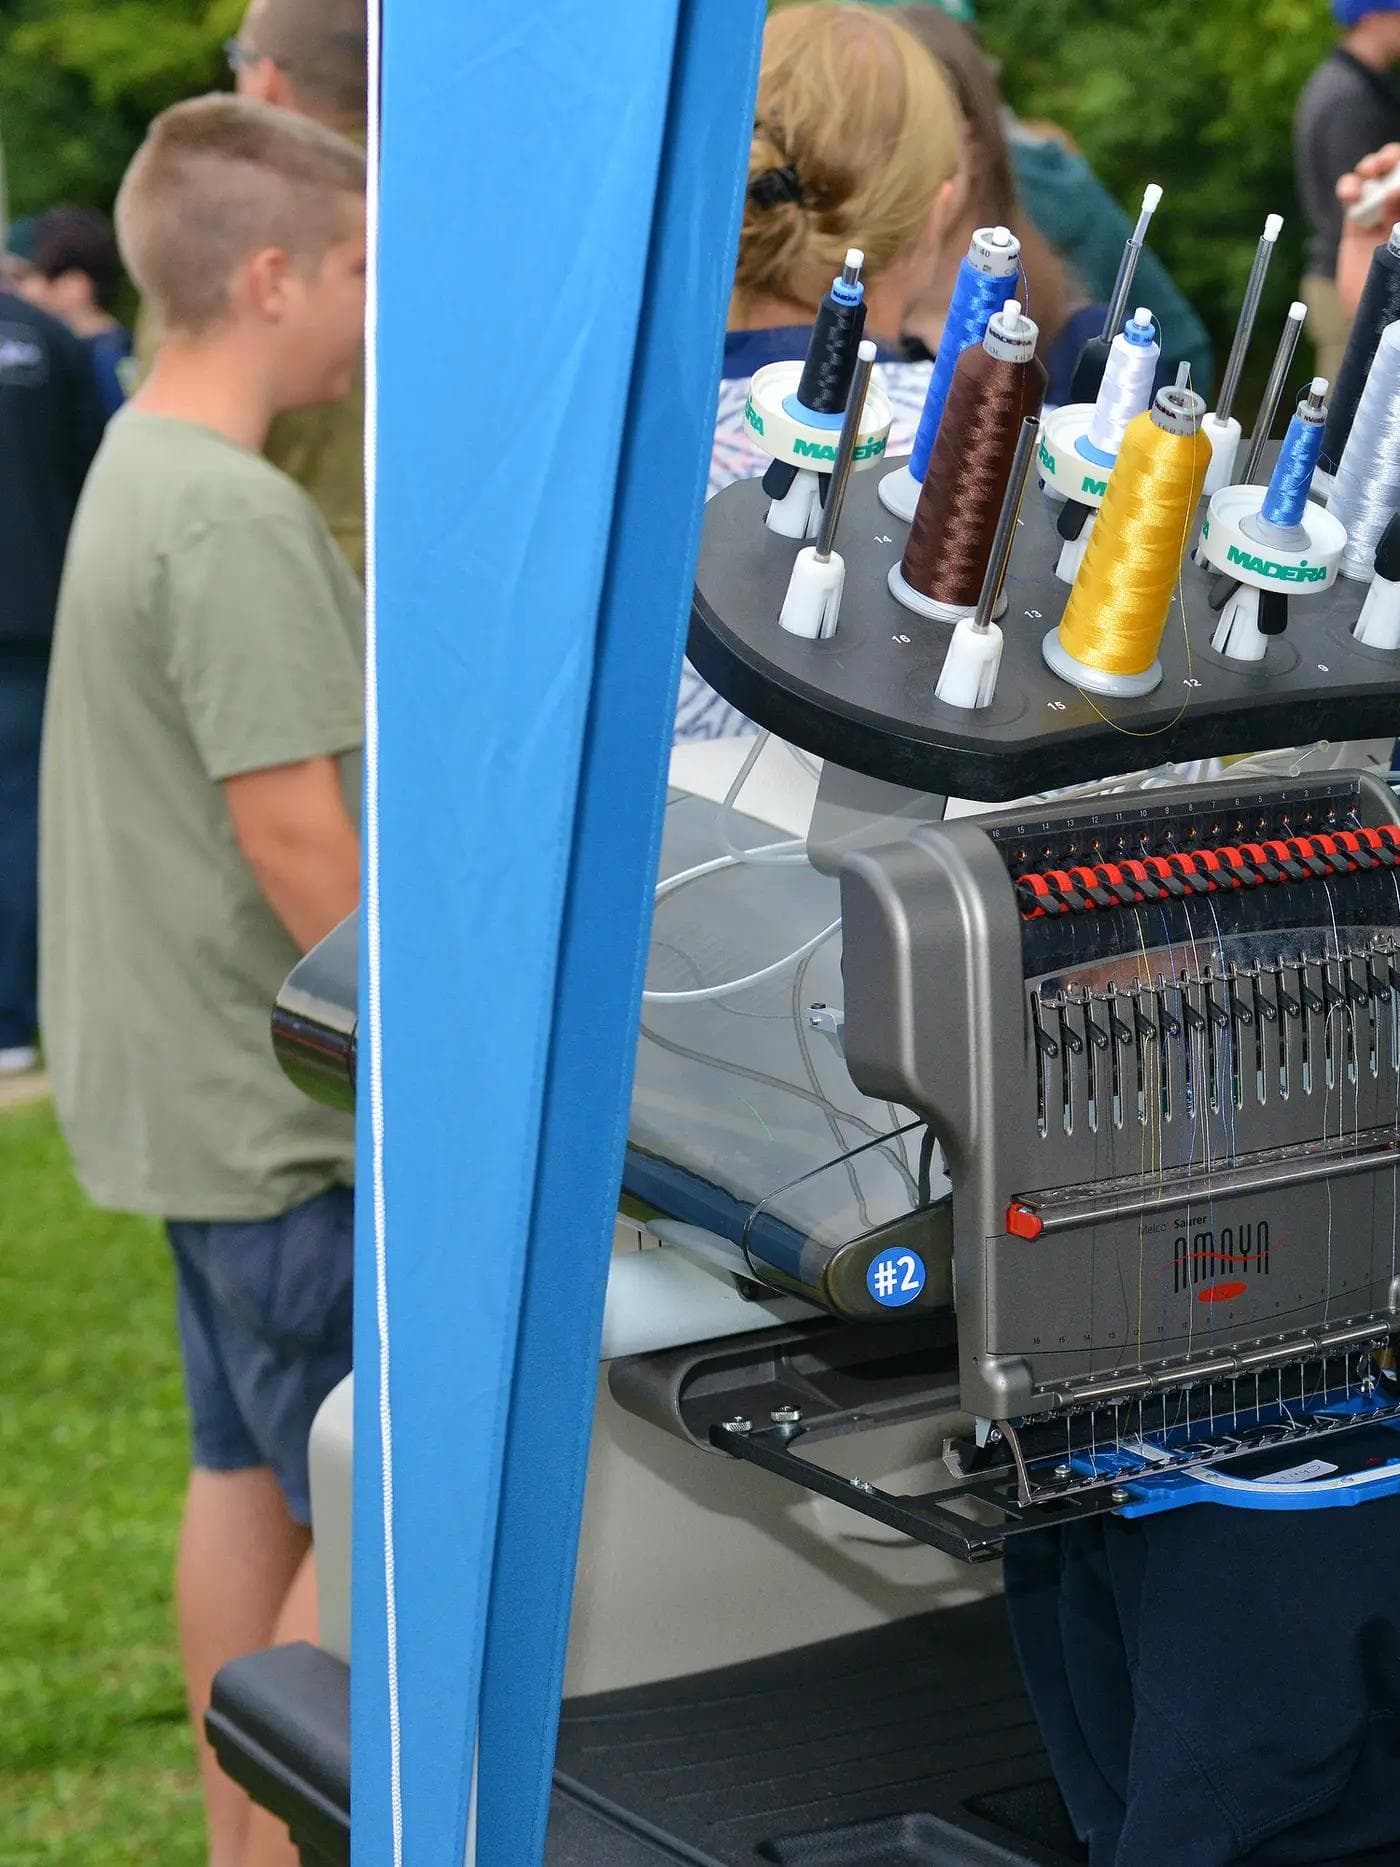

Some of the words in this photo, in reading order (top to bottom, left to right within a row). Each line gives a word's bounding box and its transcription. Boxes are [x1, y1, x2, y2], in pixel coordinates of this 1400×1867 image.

[793, 437, 887, 462] MAEIRA
[873, 535, 892, 544] 14
[1227, 545, 1327, 582] MADEIRA
[1024, 609, 1043, 619] 13
[891, 634, 911, 644] 16
[1183, 678, 1203, 688] 12
[1047, 701, 1066, 711] 15
[992, 829, 1000, 838] 16
[1017, 826, 1025, 834] 15
[1041, 822, 1050, 830] 14
[1066, 819, 1074, 827] 13
[1091, 815, 1099, 824] 12
[1115, 813, 1123, 821] 11
[1140, 809, 1147, 817] 10
[1164, 806, 1170, 815] 9
[1188, 803, 1193, 811] 8
[1212, 801, 1216, 809] 7
[1235, 798, 1240, 806] 6
[1258, 795, 1263, 803] 5
[1281, 792, 1286, 800] 4
[1304, 789, 1309, 797] 3
[1327, 786, 1332, 795] 2
[1349, 783, 1353, 791] 1
[874, 1255, 920, 1297] #2
[1033, 1337, 1041, 1345] 16
